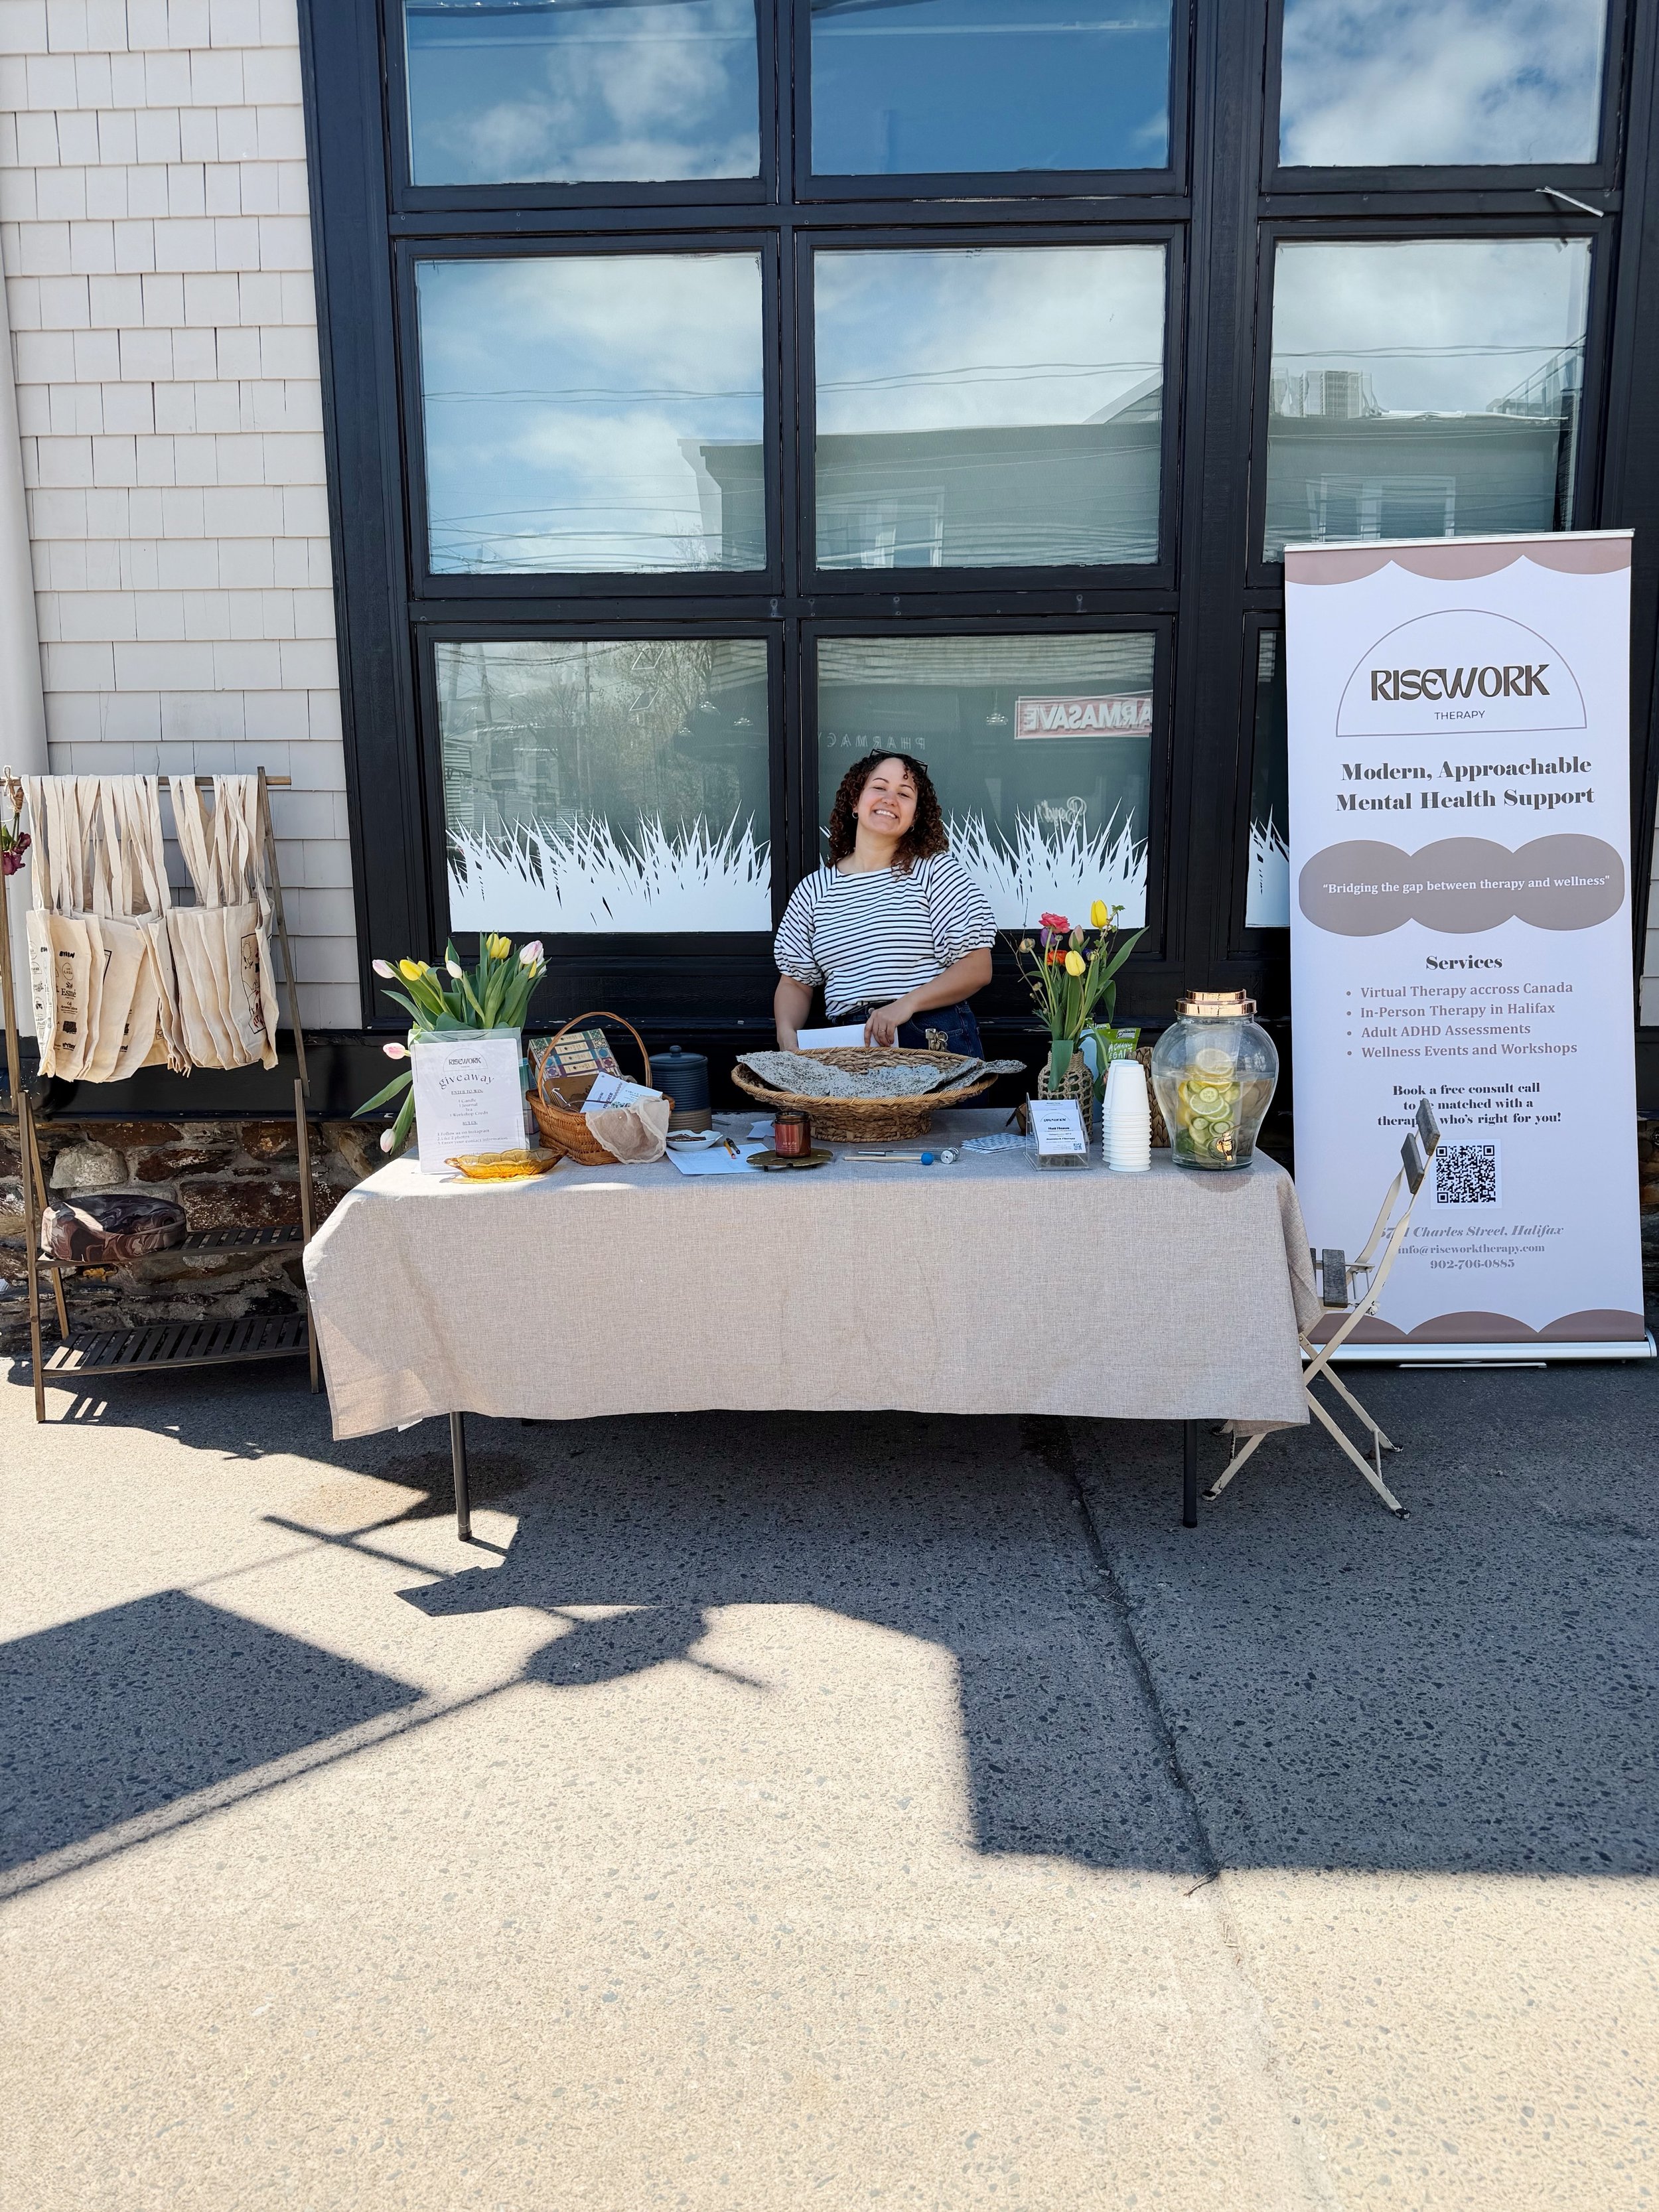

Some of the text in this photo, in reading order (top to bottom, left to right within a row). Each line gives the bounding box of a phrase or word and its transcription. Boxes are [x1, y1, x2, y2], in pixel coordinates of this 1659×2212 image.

[1372, 664, 1550, 701] RISEWORK
[1434, 711, 1485, 719] THERAPY
[1342, 757, 1591, 782] Modern, Approachable
[1336, 788, 1594, 811] Mental Health Support
[1382, 883, 1399, 891] the
[1403, 884, 1423, 893] gap
[1427, 881, 1476, 890] between
[1480, 879, 1524, 890] therapy
[1528, 877, 1550, 887] and
[1427, 955, 1502, 970] Services
[1361, 982, 1573, 998] Virtual Therapy accross Canada
[1361, 1003, 1555, 1017] In-Person Therapy in Halifax
[1362, 1025, 1530, 1037] Adult ADHD Assessments
[1362, 1043, 1577, 1057] Wellness Events and Workshops
[439, 1073, 494, 1090] giveaway
[1394, 1085, 1426, 1095] Book
[1441, 1085, 1465, 1094] free
[1469, 1083, 1513, 1093] consult
[1518, 1082, 1540, 1092] call
[1404, 1100, 1415, 1110] to
[1438, 1099, 1491, 1110] matched
[1495, 1098, 1522, 1108] with
[1478, 1114, 1508, 1126] right
[1512, 1113, 1531, 1124] for
[1535, 1112, 1561, 1124] you!
[1413, 1226, 1463, 1237] Charles
[1466, 1226, 1508, 1237] Street,
[1511, 1225, 1563, 1238] Halifax
[1398, 1244, 1545, 1254] info@riseworktherapy.com
[1431, 1259, 1515, 1270] 902-706-0885
